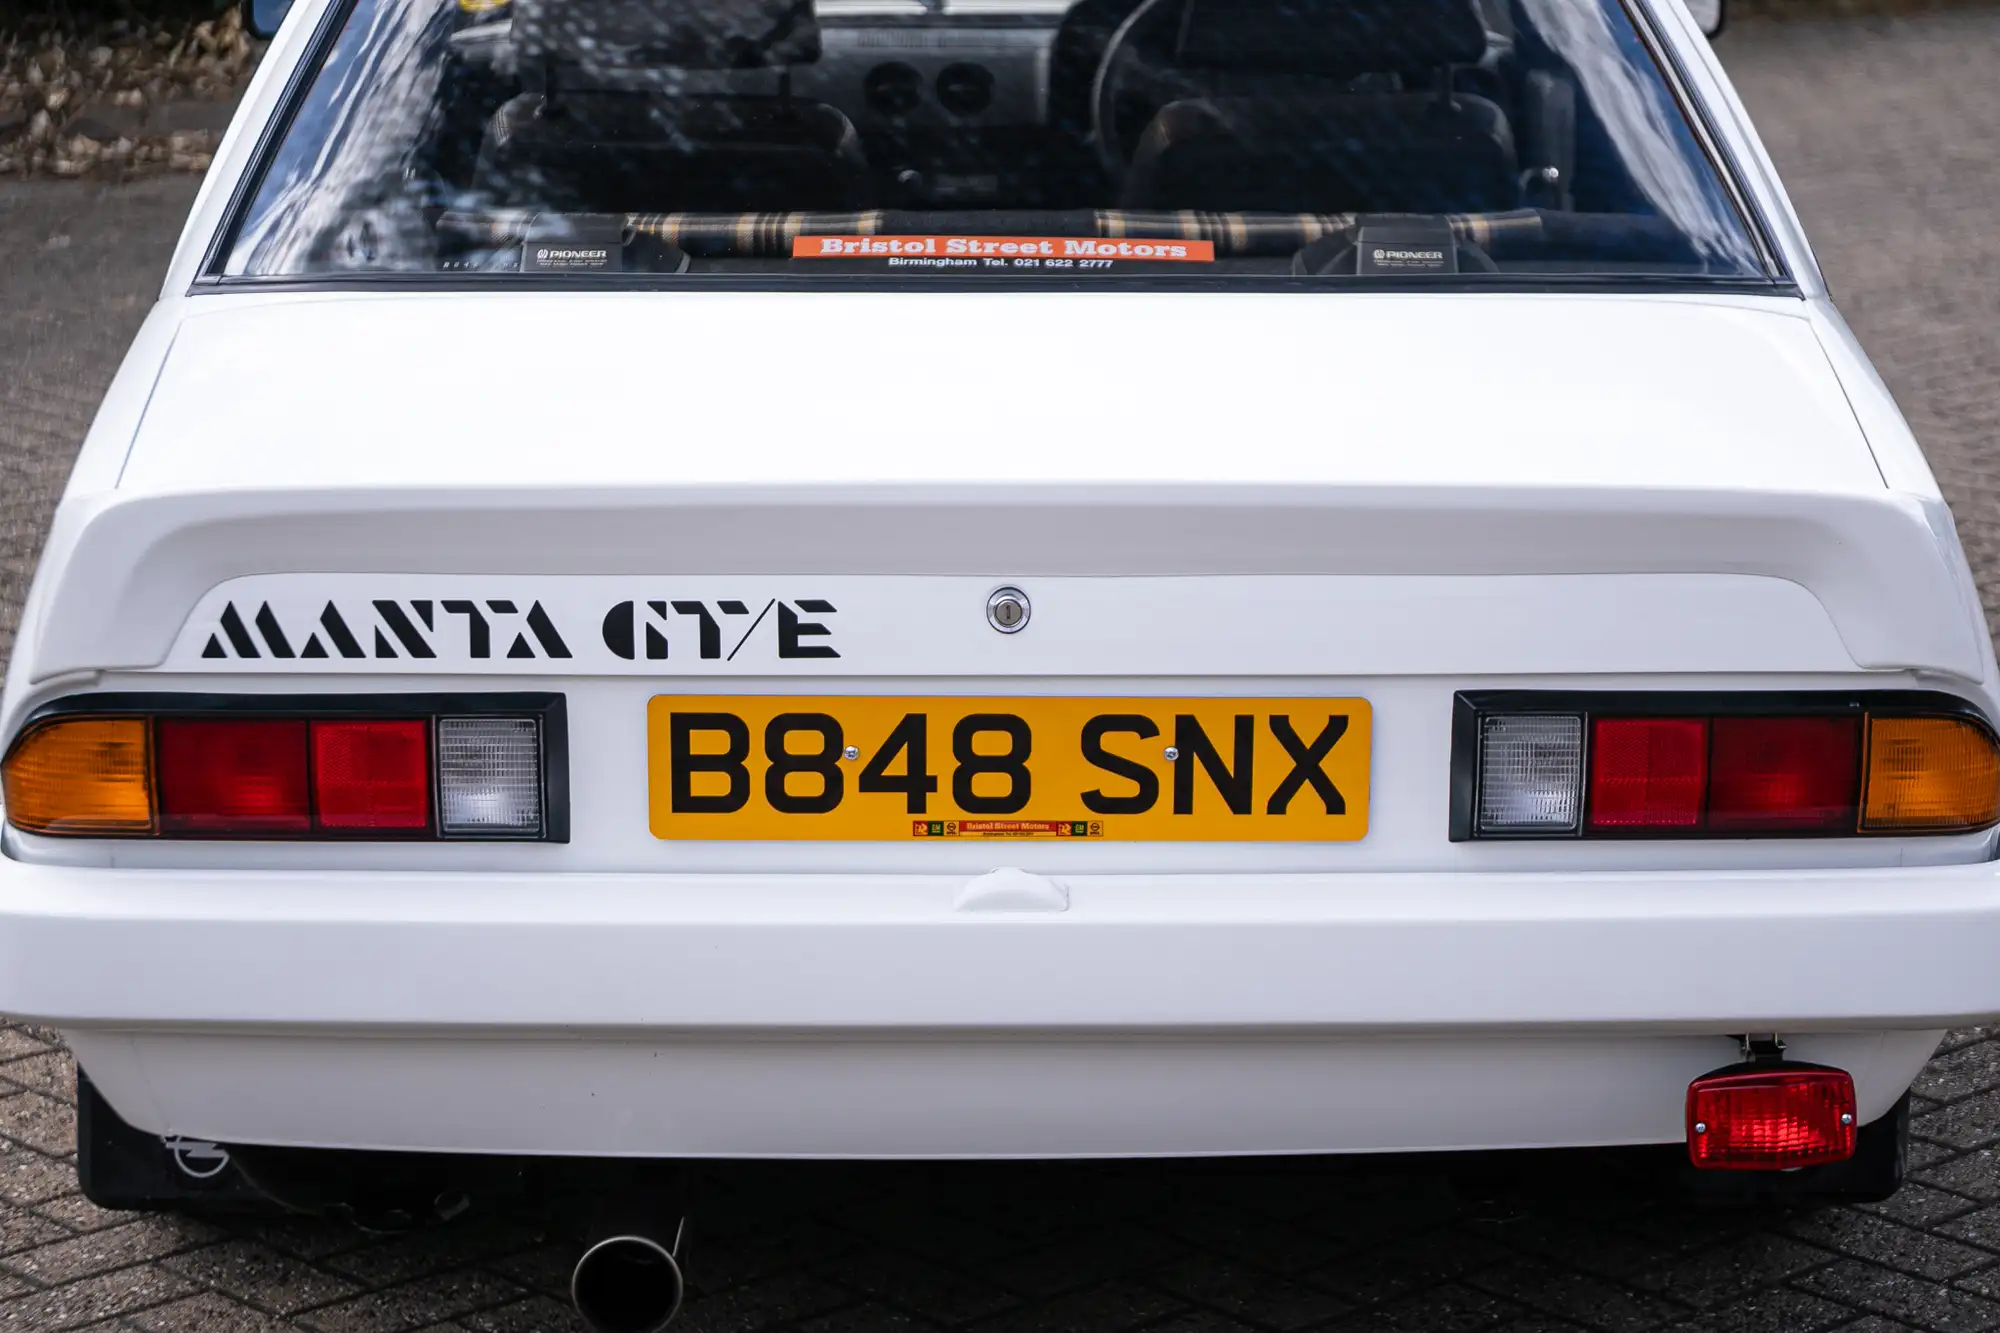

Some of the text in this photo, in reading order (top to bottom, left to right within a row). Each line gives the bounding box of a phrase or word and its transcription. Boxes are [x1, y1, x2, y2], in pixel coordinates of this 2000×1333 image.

[820, 238, 1188, 257] Bristol Street Motors
[549, 250, 607, 259] PIONEER
[1386, 250, 1443, 259] PIONEER
[888, 257, 1114, 268] Birmingham Tel. 021 622 2777
[200, 598, 842, 661] MANTA GT/E
[669, 711, 1350, 816] B848 SNX
[966, 822, 993, 831] Bristol
[994, 822, 1019, 831] Street
[1021, 822, 1049, 831] Motors
